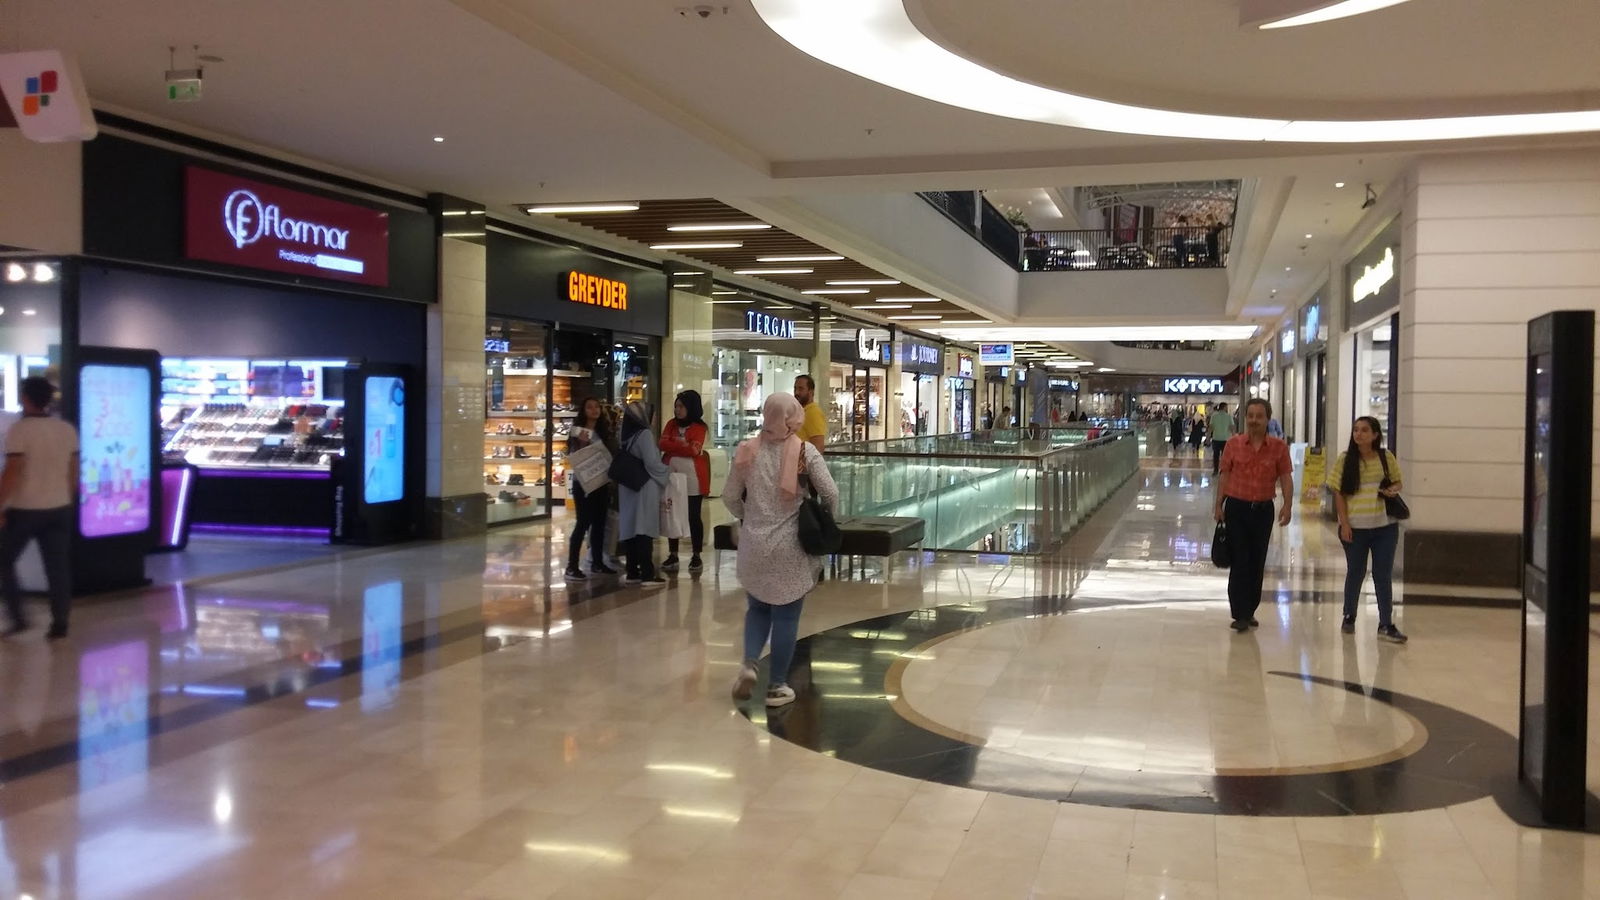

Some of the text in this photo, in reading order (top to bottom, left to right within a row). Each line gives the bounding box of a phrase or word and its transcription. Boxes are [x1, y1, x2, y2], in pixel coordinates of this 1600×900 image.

[264, 204, 349, 250] flormar
[569, 270, 627, 310] GREYDER
[747, 311, 795, 338] TERGAN
[1164, 378, 1224, 394] KOTON
